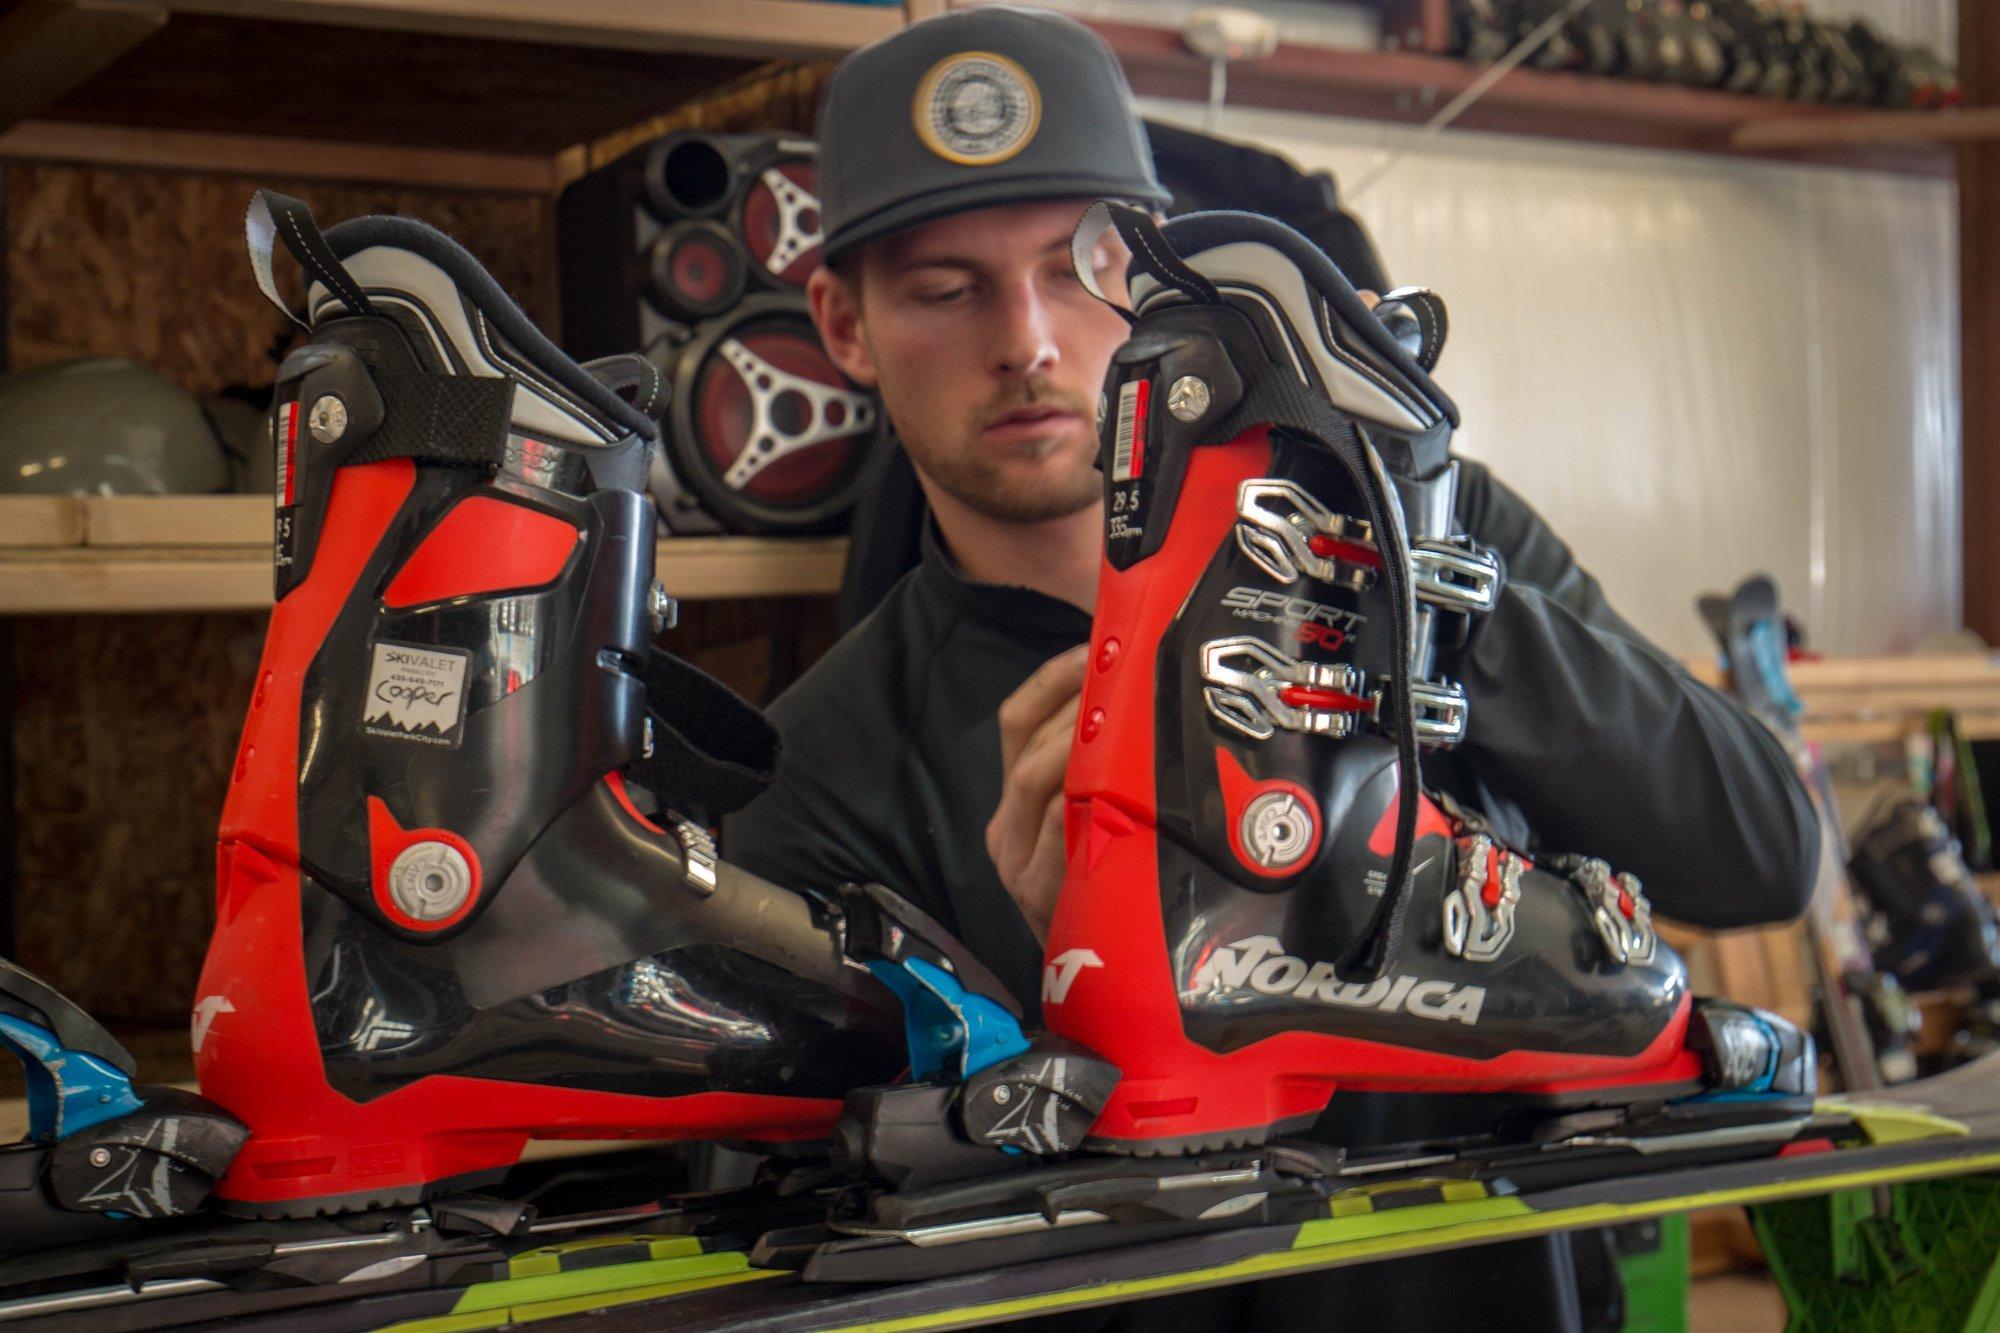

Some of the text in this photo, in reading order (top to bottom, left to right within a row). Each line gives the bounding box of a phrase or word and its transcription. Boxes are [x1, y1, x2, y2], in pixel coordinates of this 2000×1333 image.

[1220, 586, 1368, 632] SPORT
[376, 679, 456, 711] Cooper
[1193, 934, 1487, 1026] NORDICA
